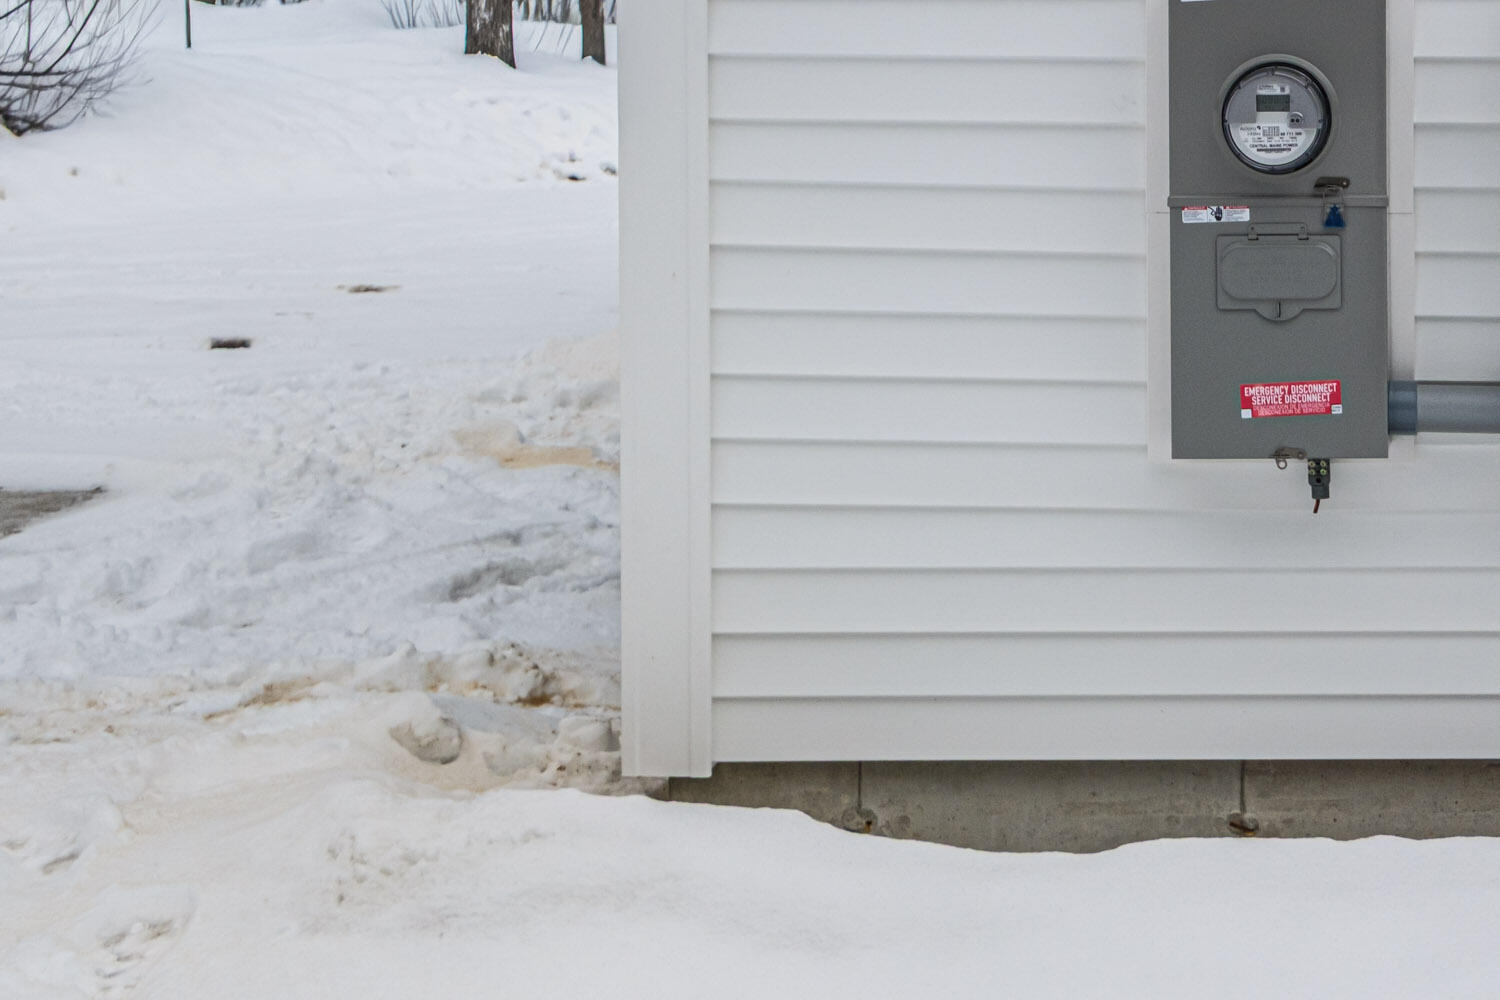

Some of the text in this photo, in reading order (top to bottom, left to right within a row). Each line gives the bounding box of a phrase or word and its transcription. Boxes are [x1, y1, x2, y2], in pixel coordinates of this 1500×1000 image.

[1244, 382, 1337, 397] EMERGENCY DISCONNECT
[1251, 392, 1331, 406] SERVICE DISCONNECT
